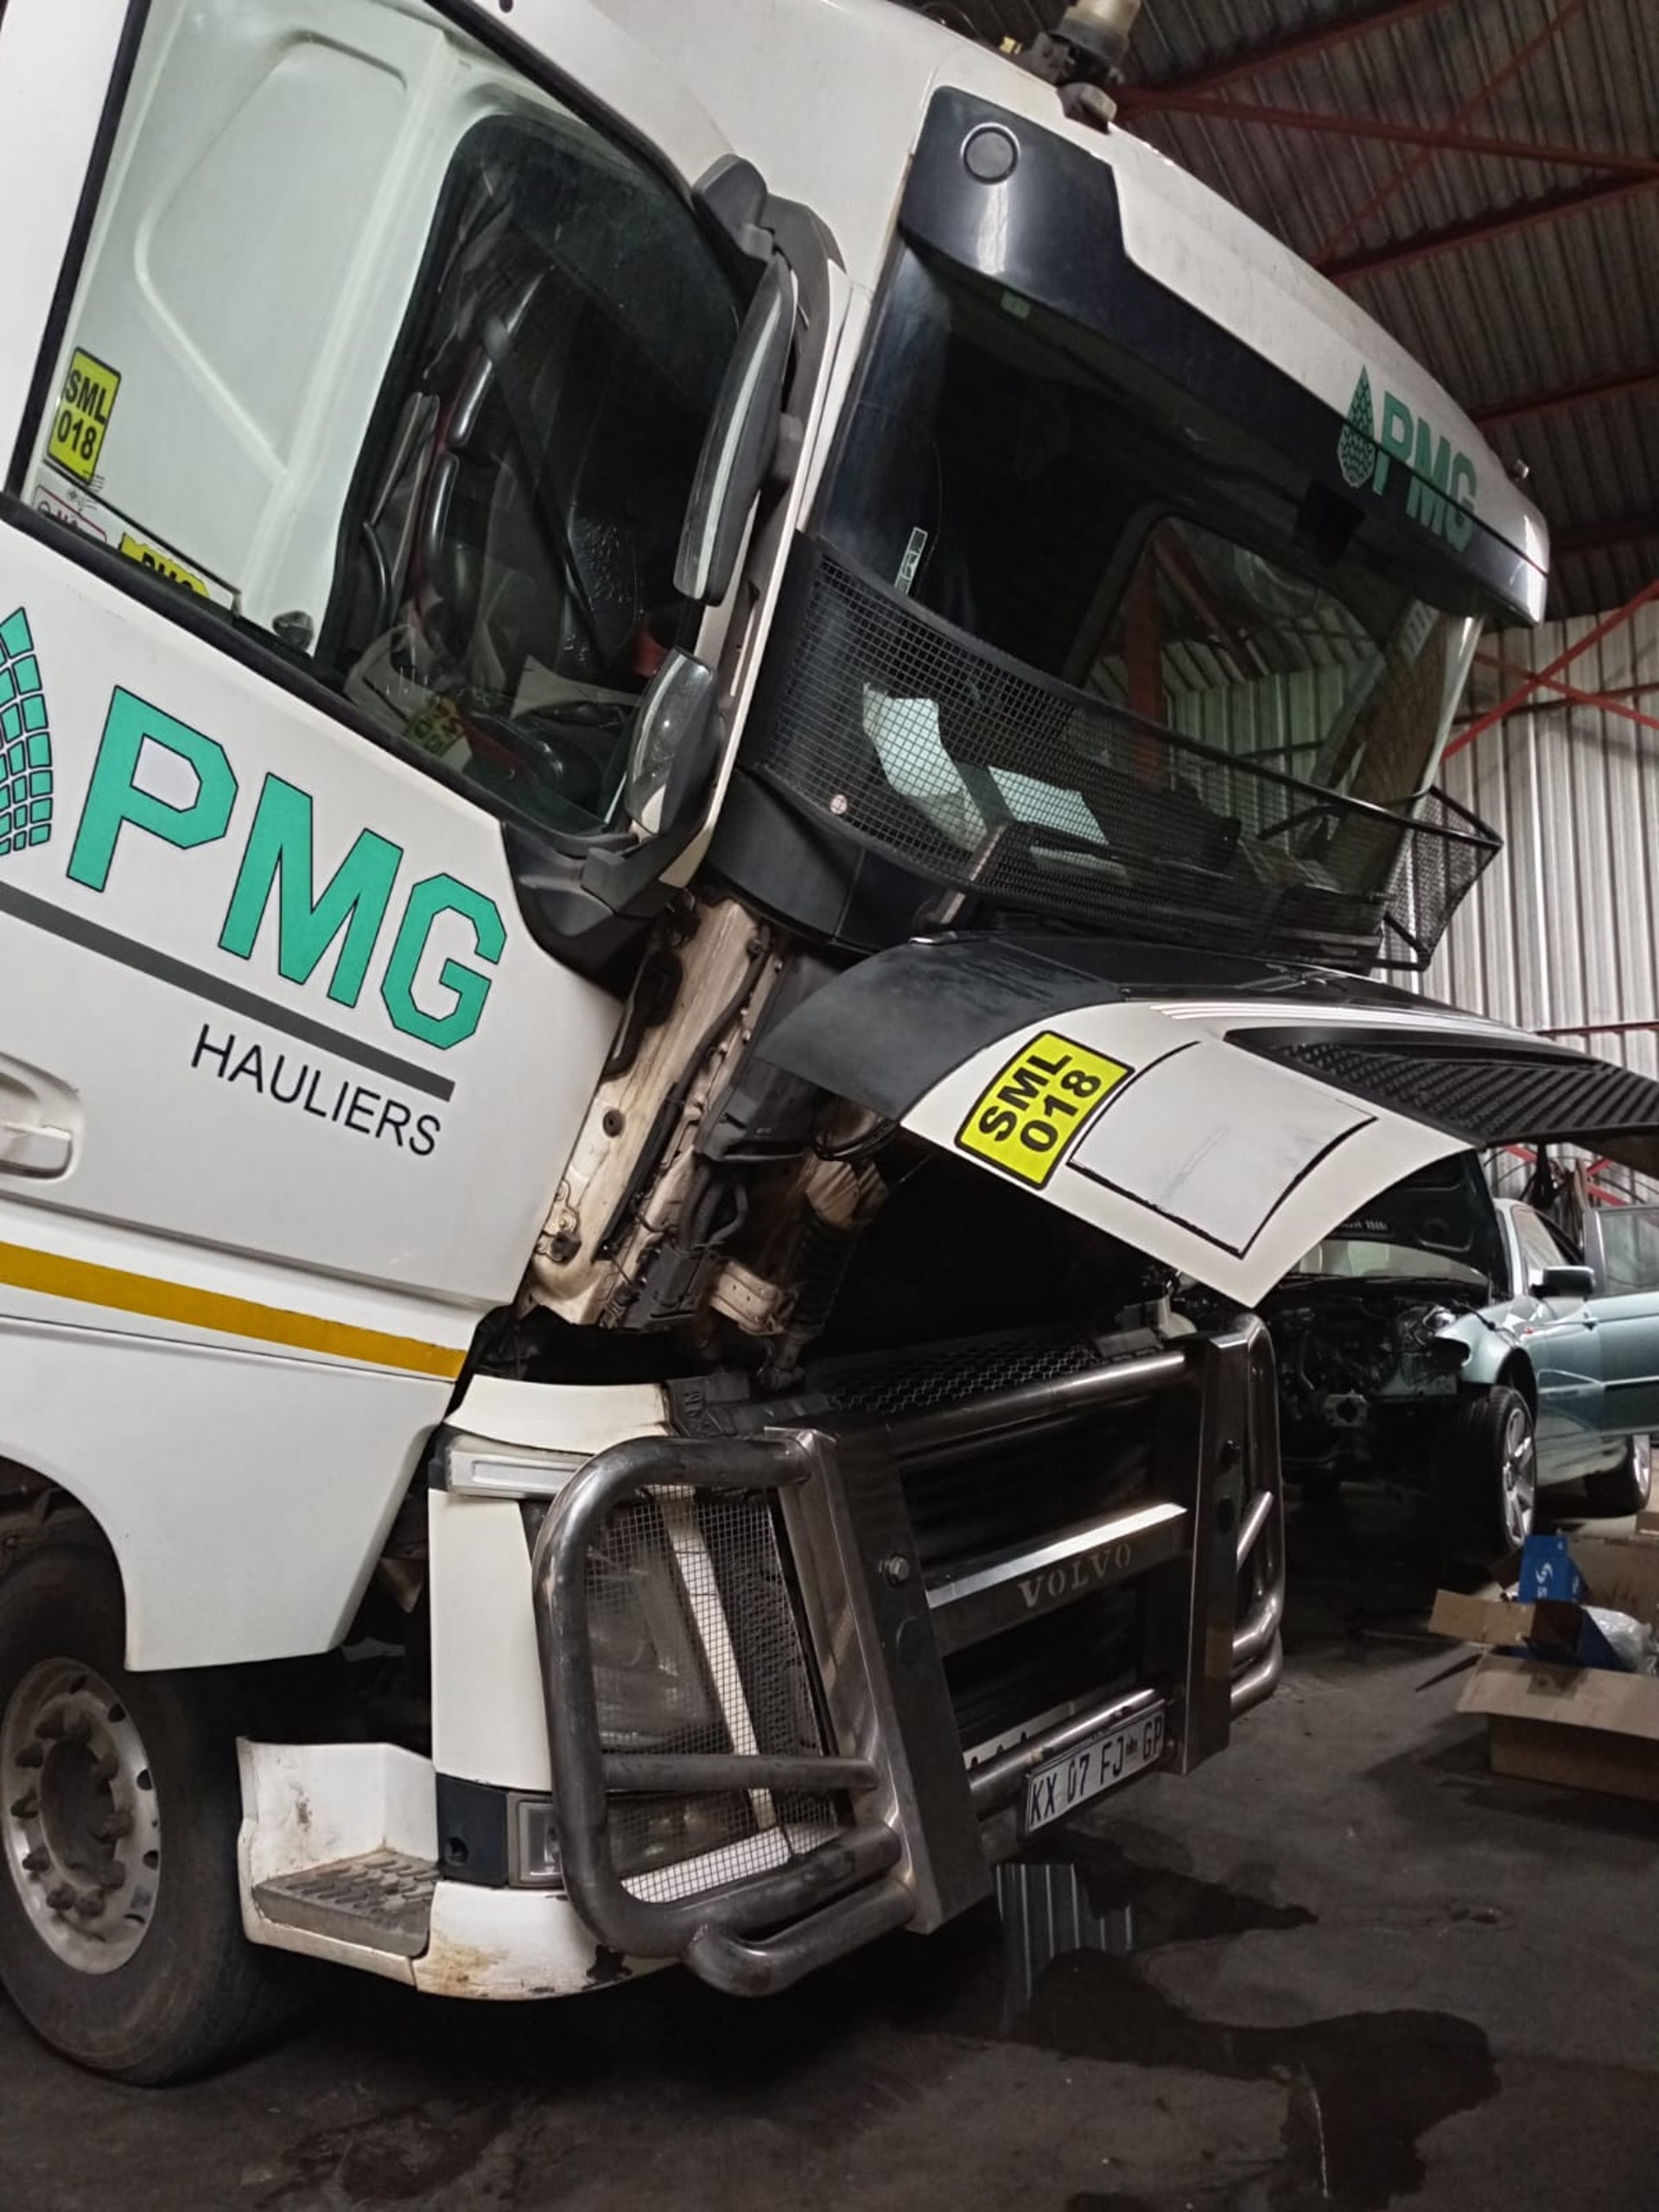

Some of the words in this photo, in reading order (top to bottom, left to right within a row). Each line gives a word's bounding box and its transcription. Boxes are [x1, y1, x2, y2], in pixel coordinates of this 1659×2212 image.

[57, 410, 97, 461] 018
[65, 369, 107, 425] SML
[1371, 391, 1478, 553] PMG
[67, 684, 507, 1051] PMG
[190, 1023, 442, 1156] HAULIERS
[978, 1054, 1073, 1142] SML
[1020, 1070, 1102, 1153] 018
[1018, 1544, 1131, 1608] VOLVO
[1030, 1772, 1058, 1826] KX
[1067, 1753, 1090, 1804] 07
[1100, 1735, 1123, 1785] FJ
[1142, 1716, 1163, 1760] GP
